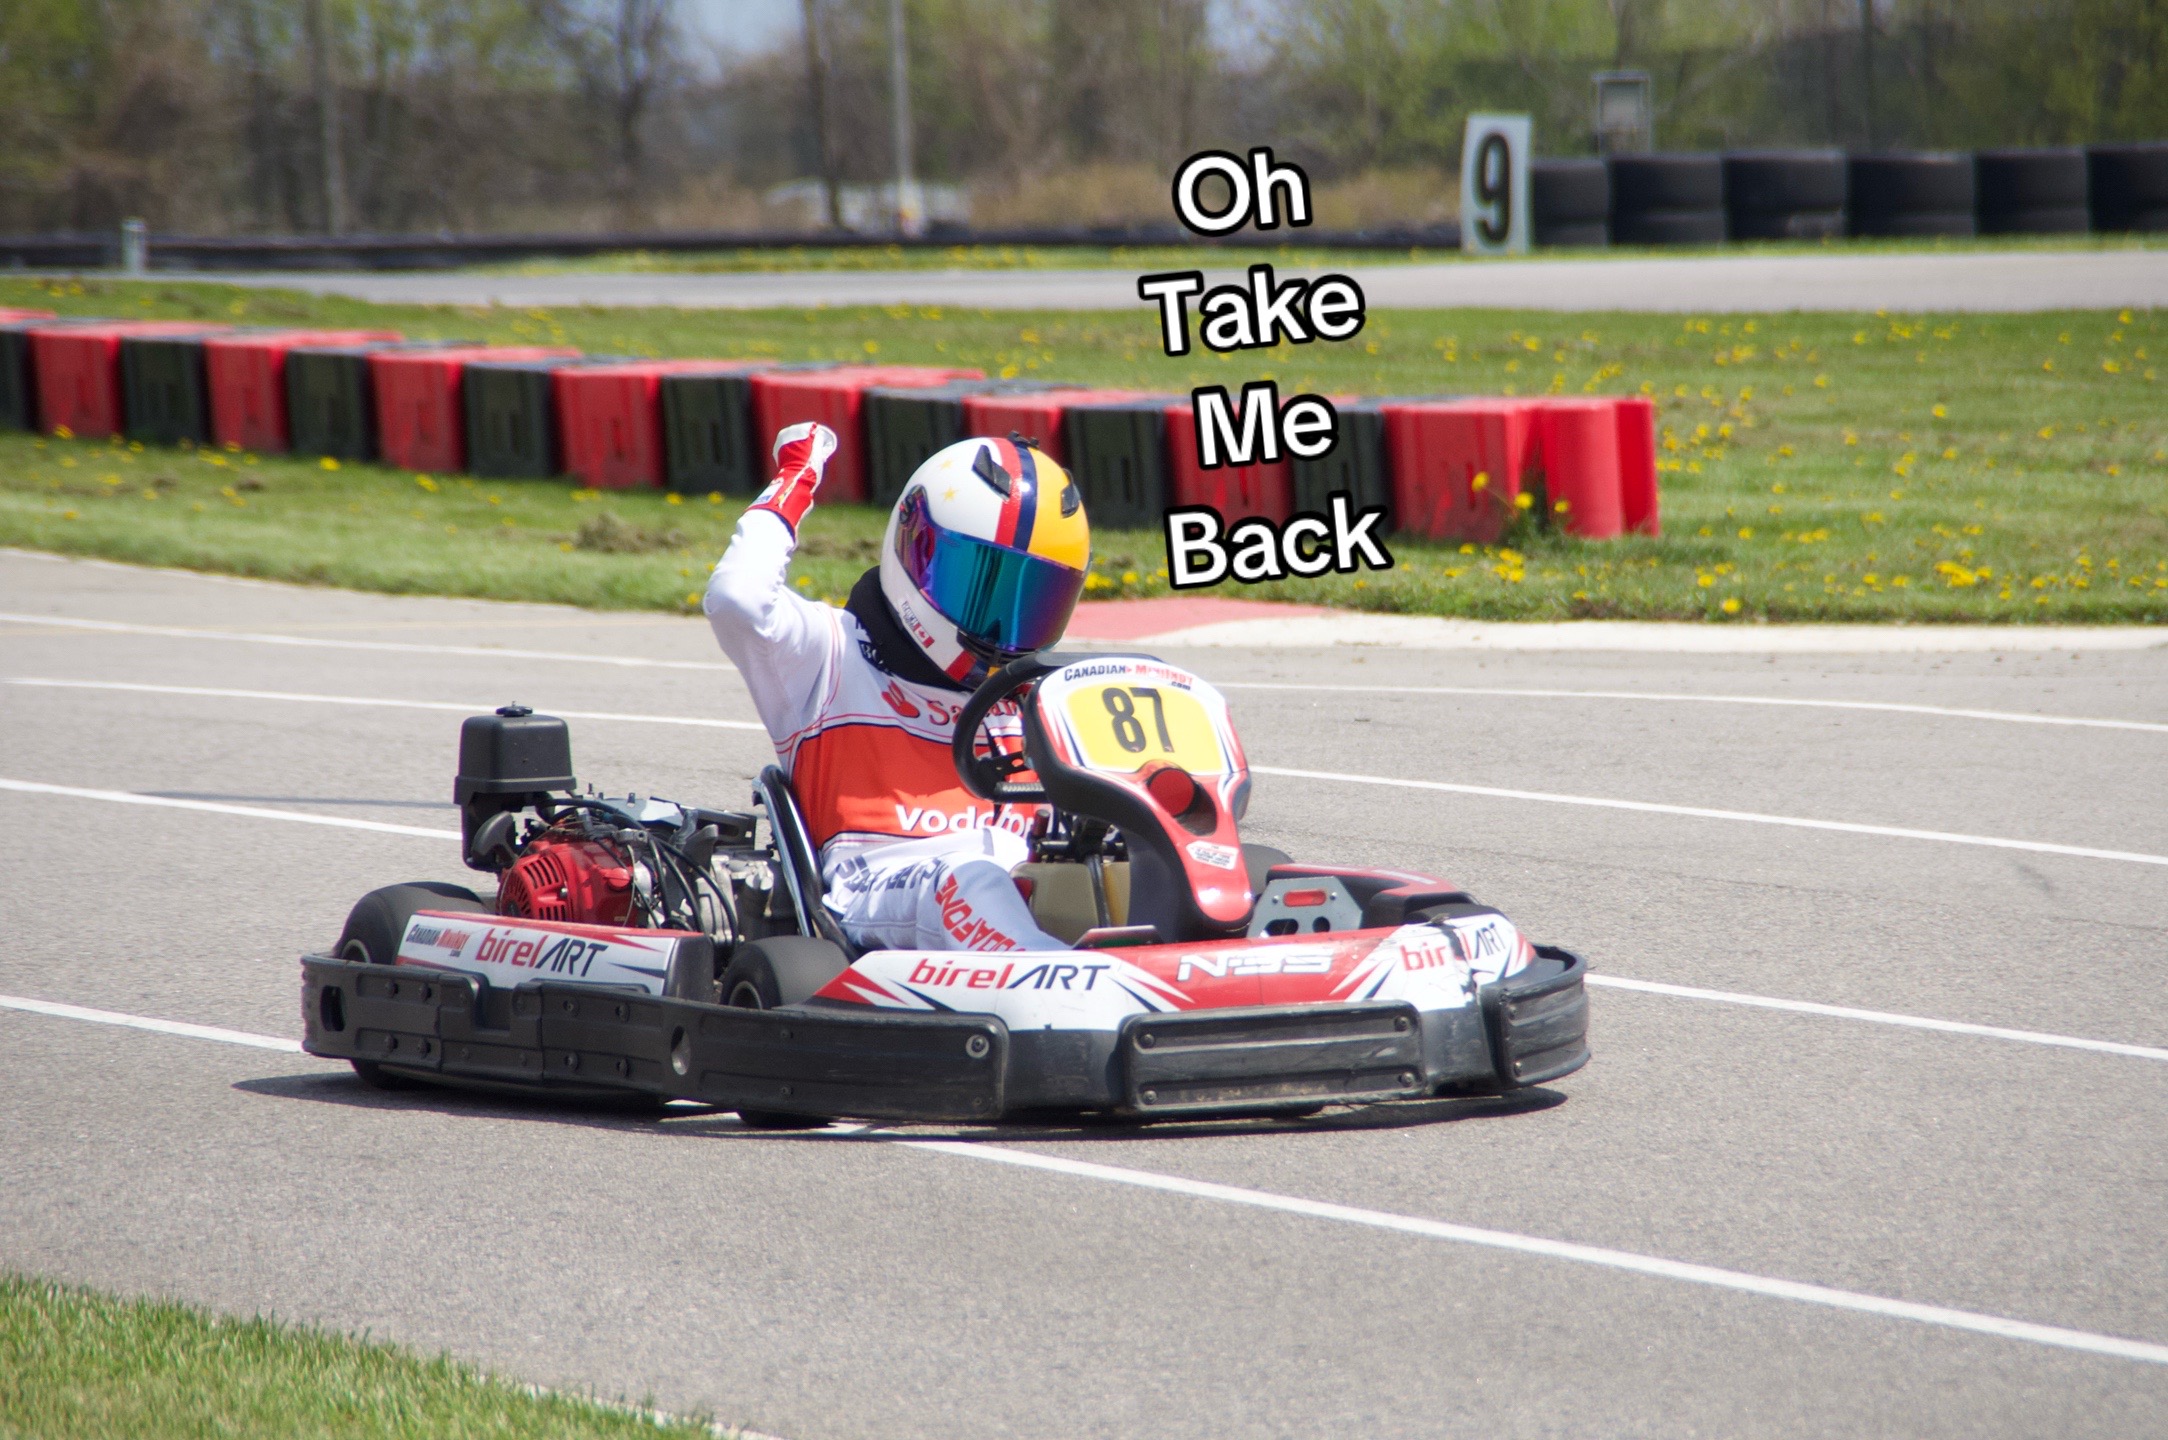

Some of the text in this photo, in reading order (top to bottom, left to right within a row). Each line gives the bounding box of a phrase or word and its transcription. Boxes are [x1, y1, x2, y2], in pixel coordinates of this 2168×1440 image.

[1475, 131, 1512, 247] 9
[1064, 664, 1126, 681] CANADIAN
[1102, 687, 1175, 753] 87
[894, 803, 1035, 839] vodafo
[935, 872, 1024, 951] DAFONE
[1400, 922, 1506, 971] birlART
